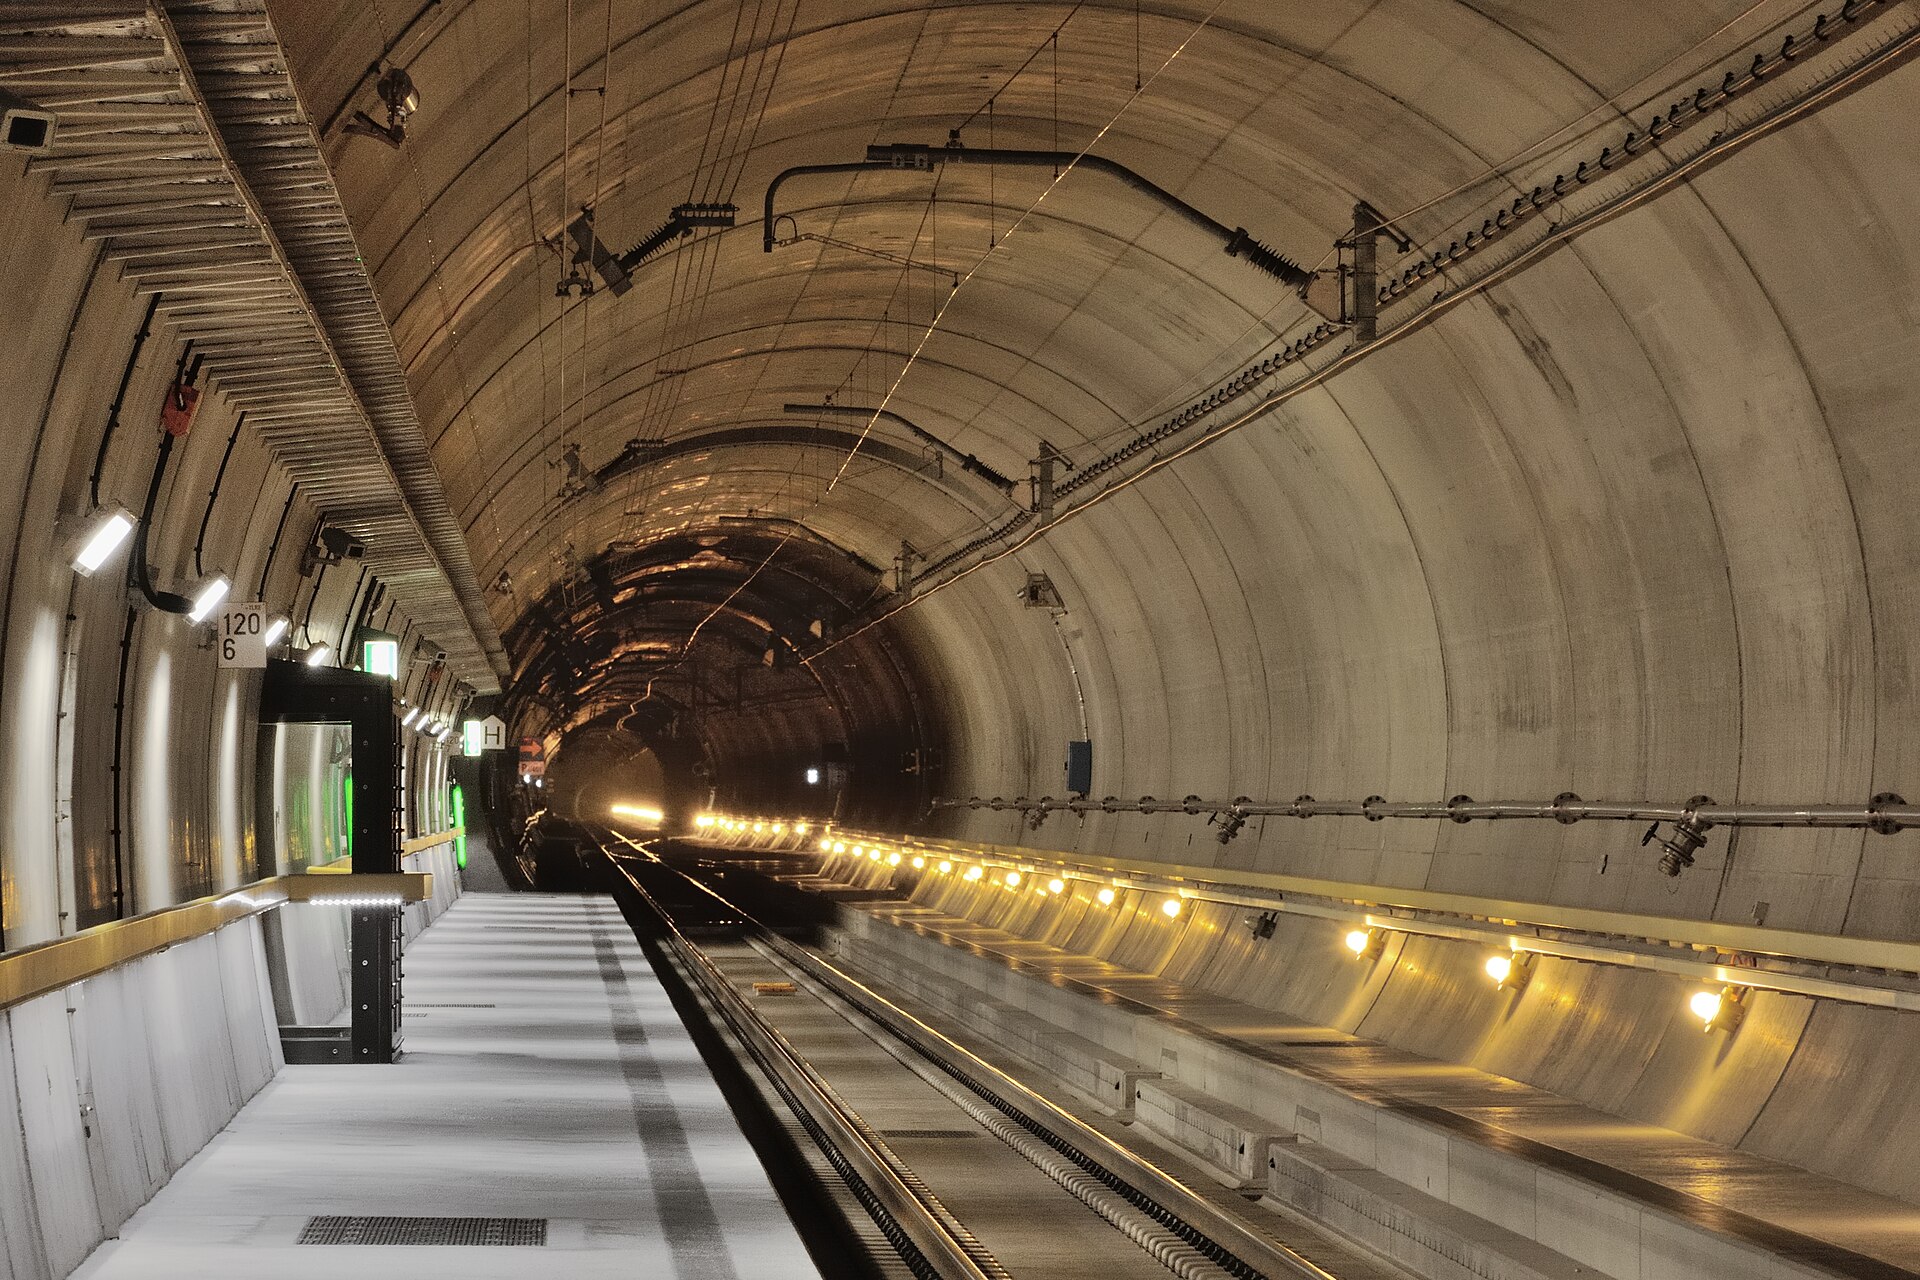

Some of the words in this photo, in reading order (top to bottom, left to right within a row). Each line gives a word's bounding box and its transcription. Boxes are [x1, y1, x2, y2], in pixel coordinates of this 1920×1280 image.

[223, 612, 260, 635] 120
[223, 638, 236, 660] 6
[484, 725, 500, 745] H
